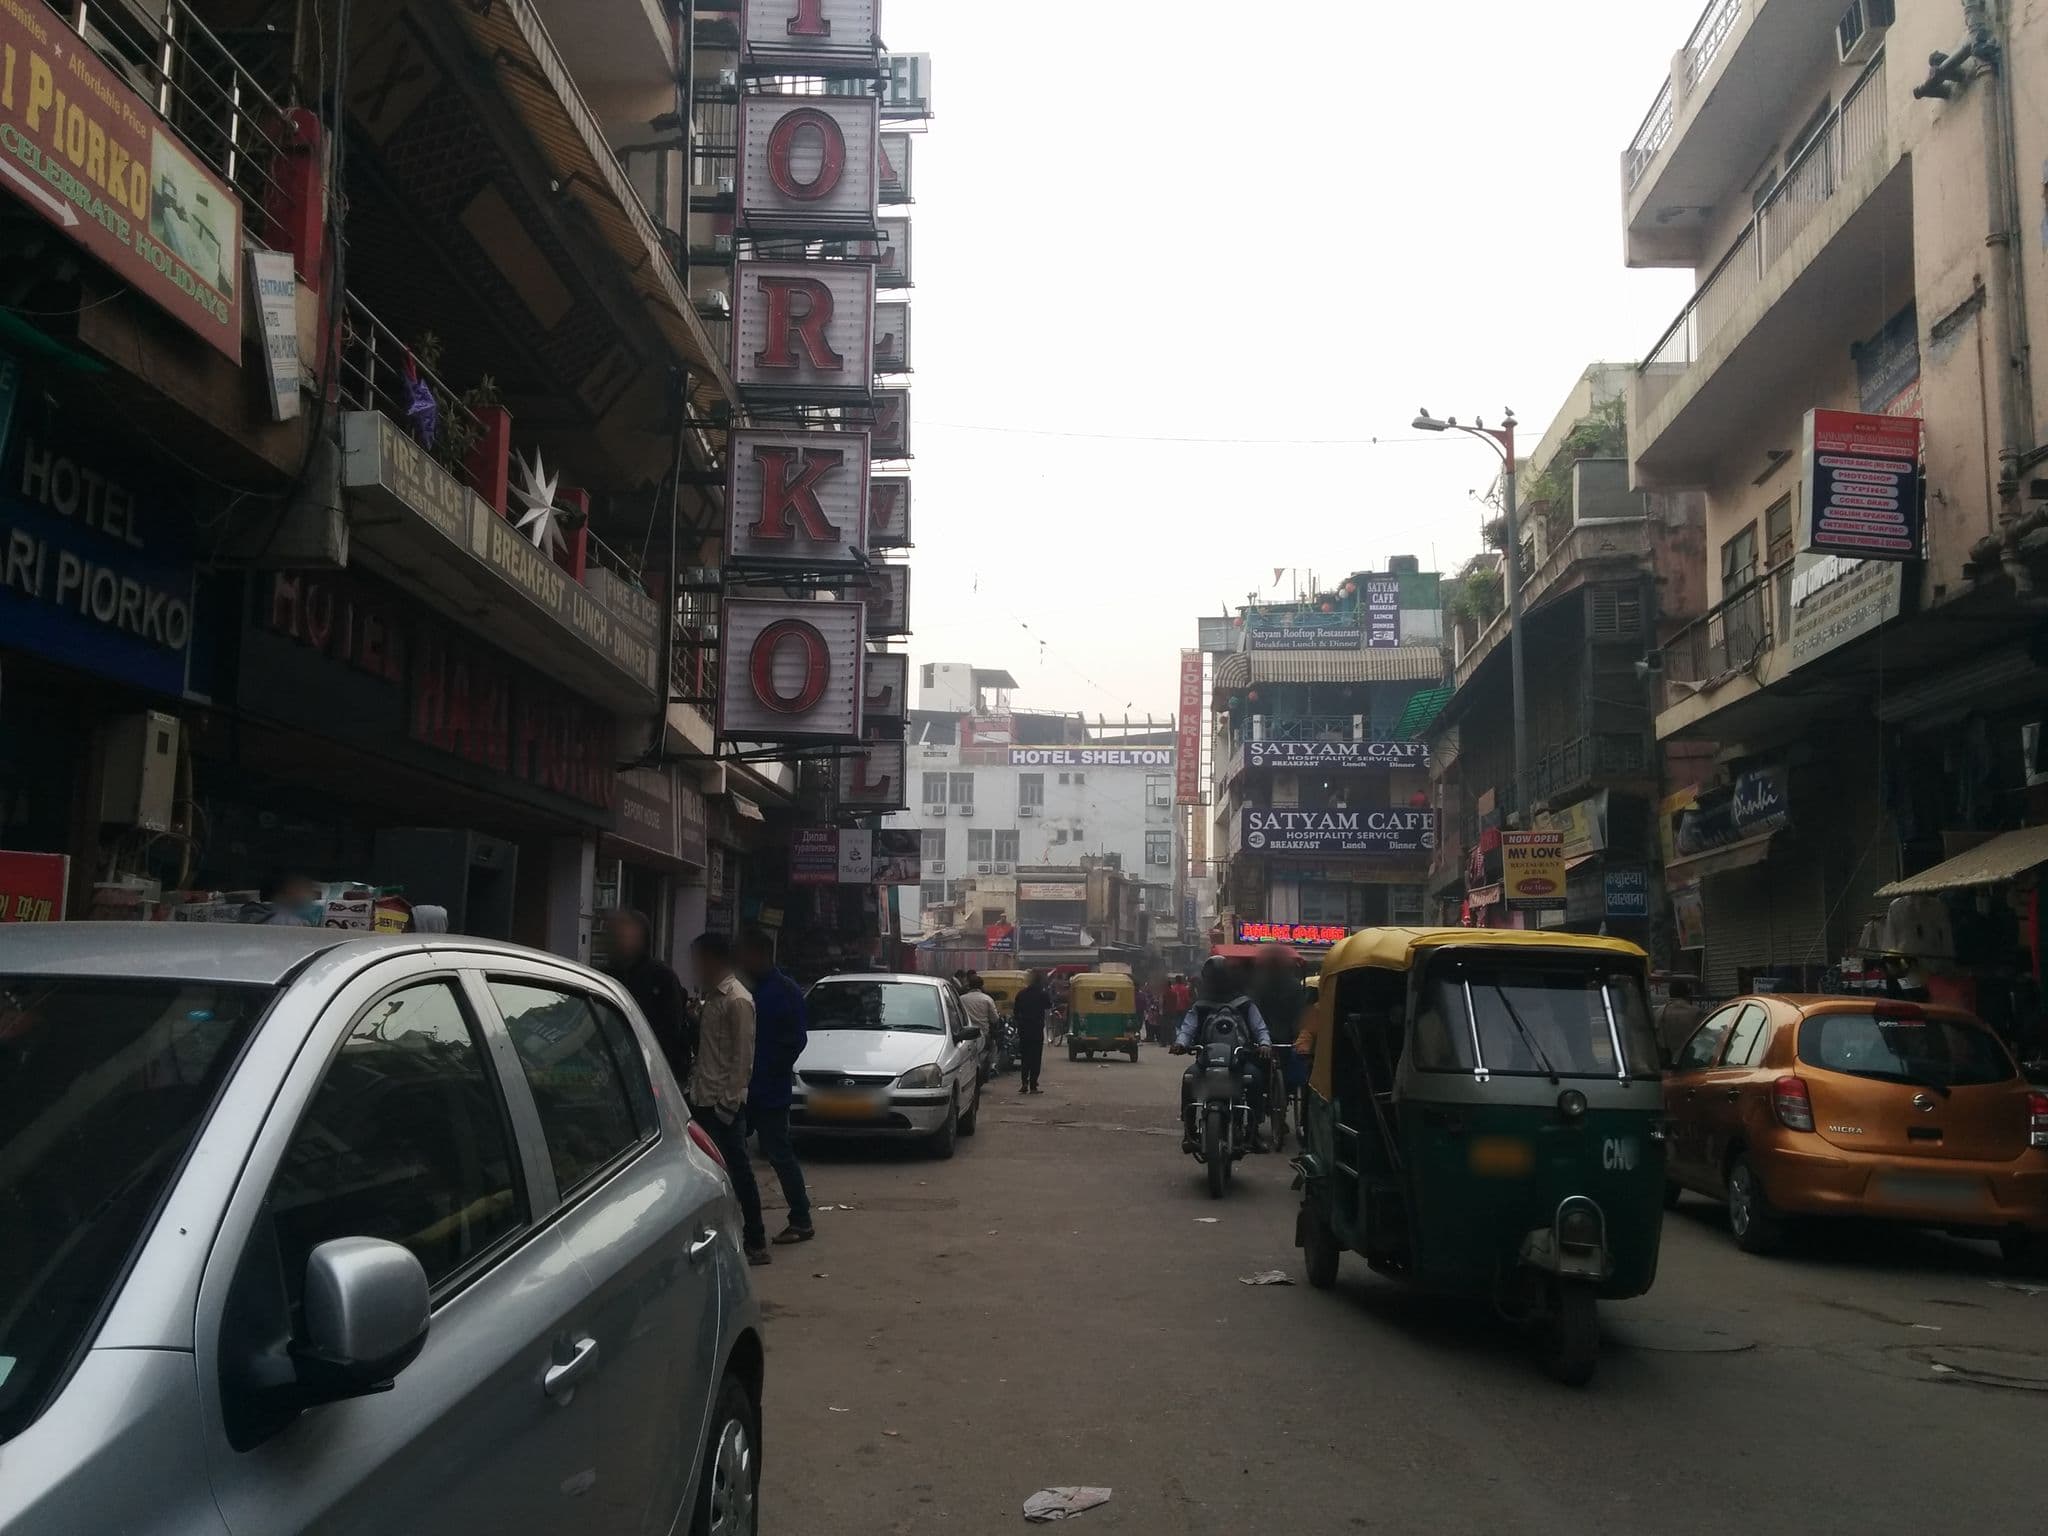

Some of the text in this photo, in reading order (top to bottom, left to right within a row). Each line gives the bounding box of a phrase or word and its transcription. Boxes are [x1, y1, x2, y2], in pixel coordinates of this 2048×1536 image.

[69, 53, 120, 116] Affordable
[123, 103, 147, 139] Price
[26, 50, 147, 221] PIORKO
[0, 123, 230, 325] CELEBRATE HOLIDAYS
[260, 278, 295, 297] ENTRANCE
[1839, 472, 1892, 481] PHOTOSHOP
[21, 436, 145, 549] HOTEL
[1843, 485, 1887, 494] TYPING
[440, 477, 463, 520] ICE
[1367, 582, 1399, 592] SATYAM
[56, 550, 190, 650] PIORKO
[493, 523, 566, 613] BREAKFAST
[573, 592, 608, 647] LUNCH
[614, 627, 646, 680] DINNER
[1372, 593, 1395, 603] CAFE
[1252, 628, 1360, 640] Satyam Rooftop Restaurant
[1250, 743, 1359, 755] SATYAM
[1012, 750, 1170, 764] HOTEL SHELTON
[1249, 812, 1434, 830] SATYAM CAFE
[1357, 832, 1400, 840] SERVICE
[1508, 834, 1559, 843] NOW OPEN
[1270, 841, 1417, 849] BREAKFAST Lunch Dinner
[1508, 848, 1561, 859] MY LOVE
[1829, 1125, 1863, 1134] MICRA
